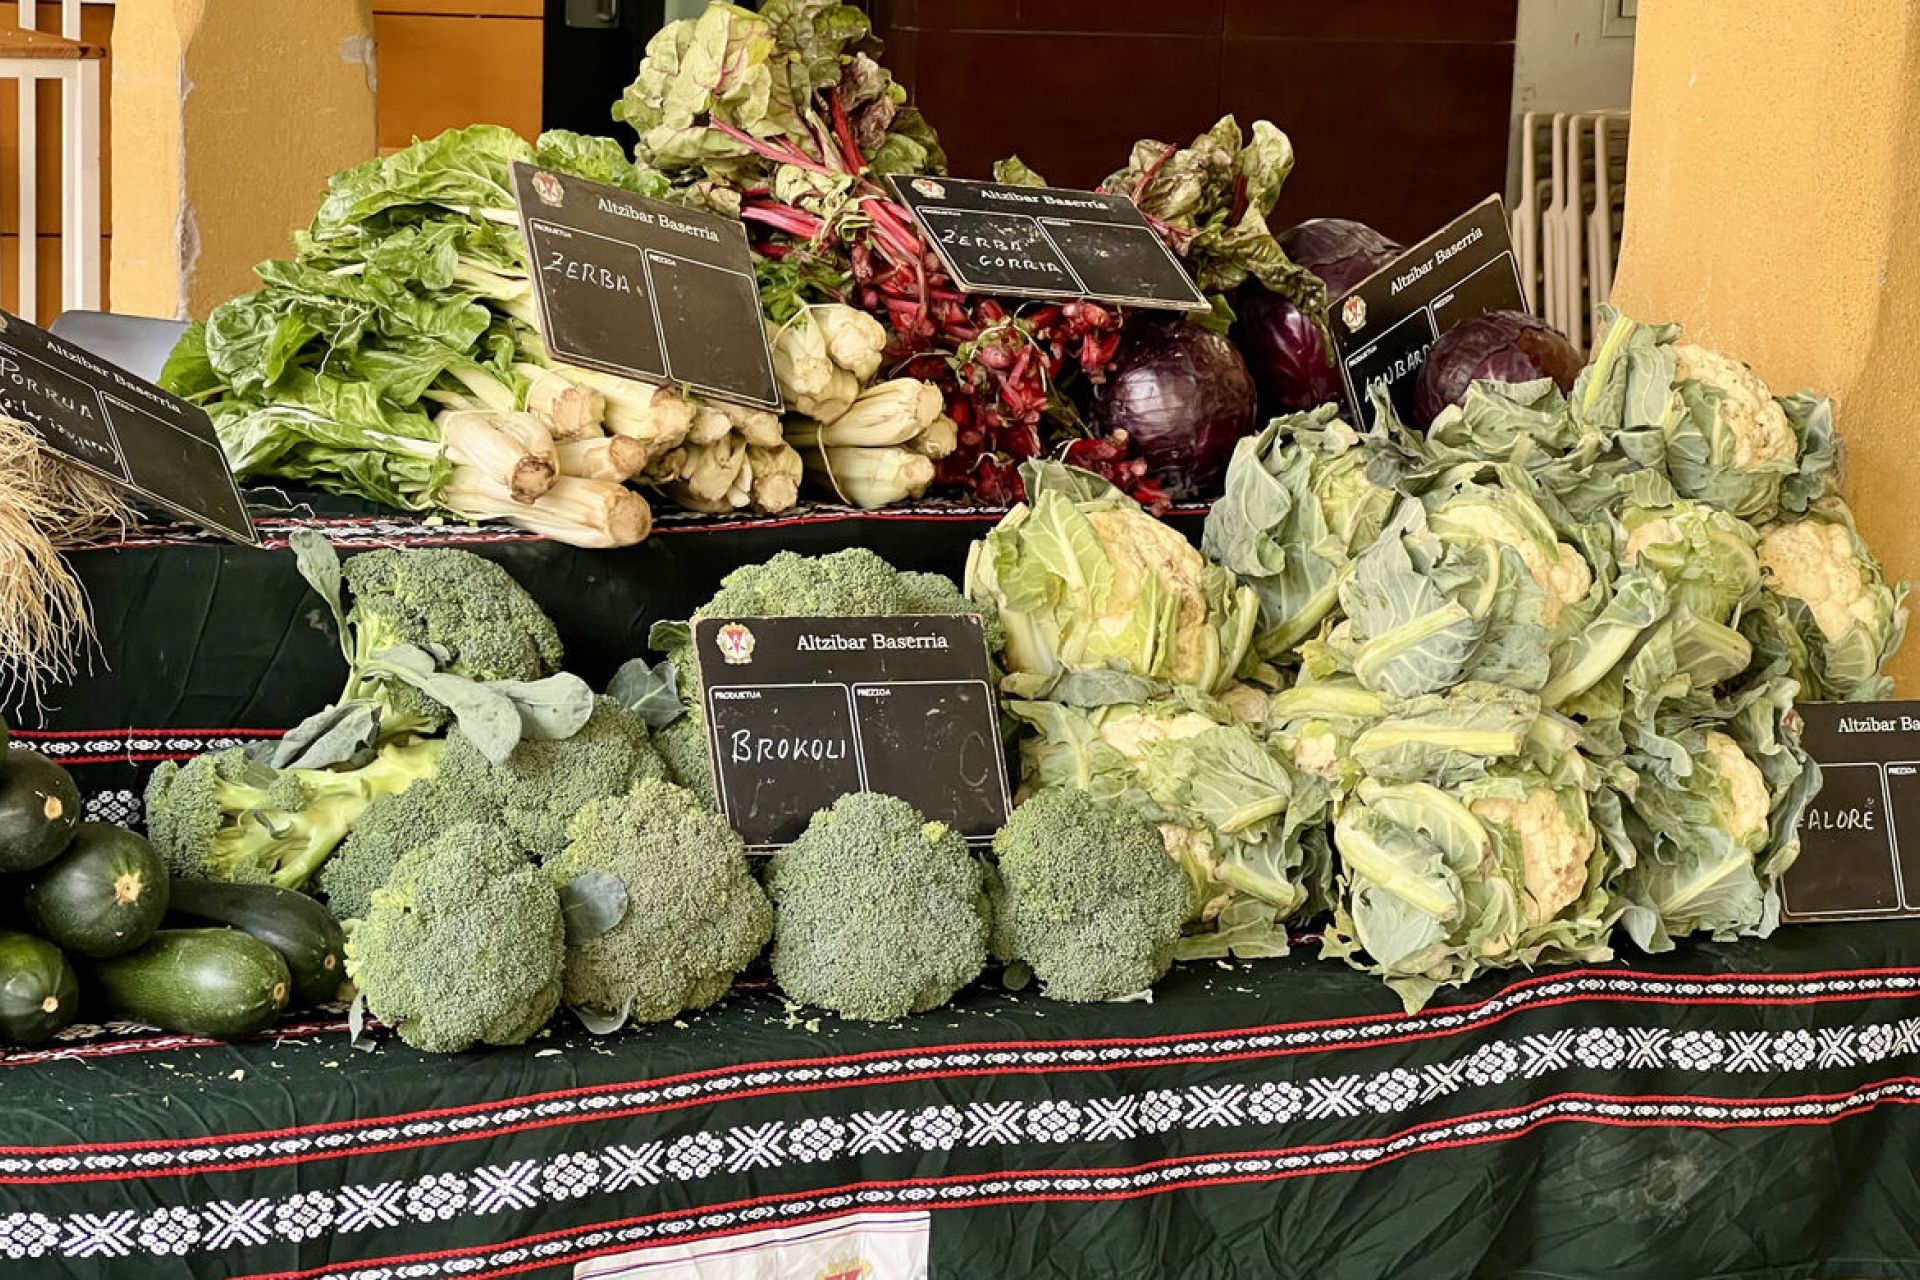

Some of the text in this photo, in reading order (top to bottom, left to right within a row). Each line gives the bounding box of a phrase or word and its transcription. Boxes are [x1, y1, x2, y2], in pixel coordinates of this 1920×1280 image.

[981, 189, 1109, 209] Altzibar Baserria
[598, 198, 720, 242] Altzibar Baserria
[942, 229, 1023, 251] ZERBA
[543, 251, 631, 294] ZERBA
[979, 255, 1064, 274] GORRIA
[1391, 227, 1483, 296] Altzibar Baserria
[47, 341, 109, 377] Altzibar
[113, 372, 182, 413] Baserria
[797, 632, 949, 651] Altzibar Baserria
[1838, 717, 1897, 733] Altzibar
[731, 728, 846, 763] BROKOLI
